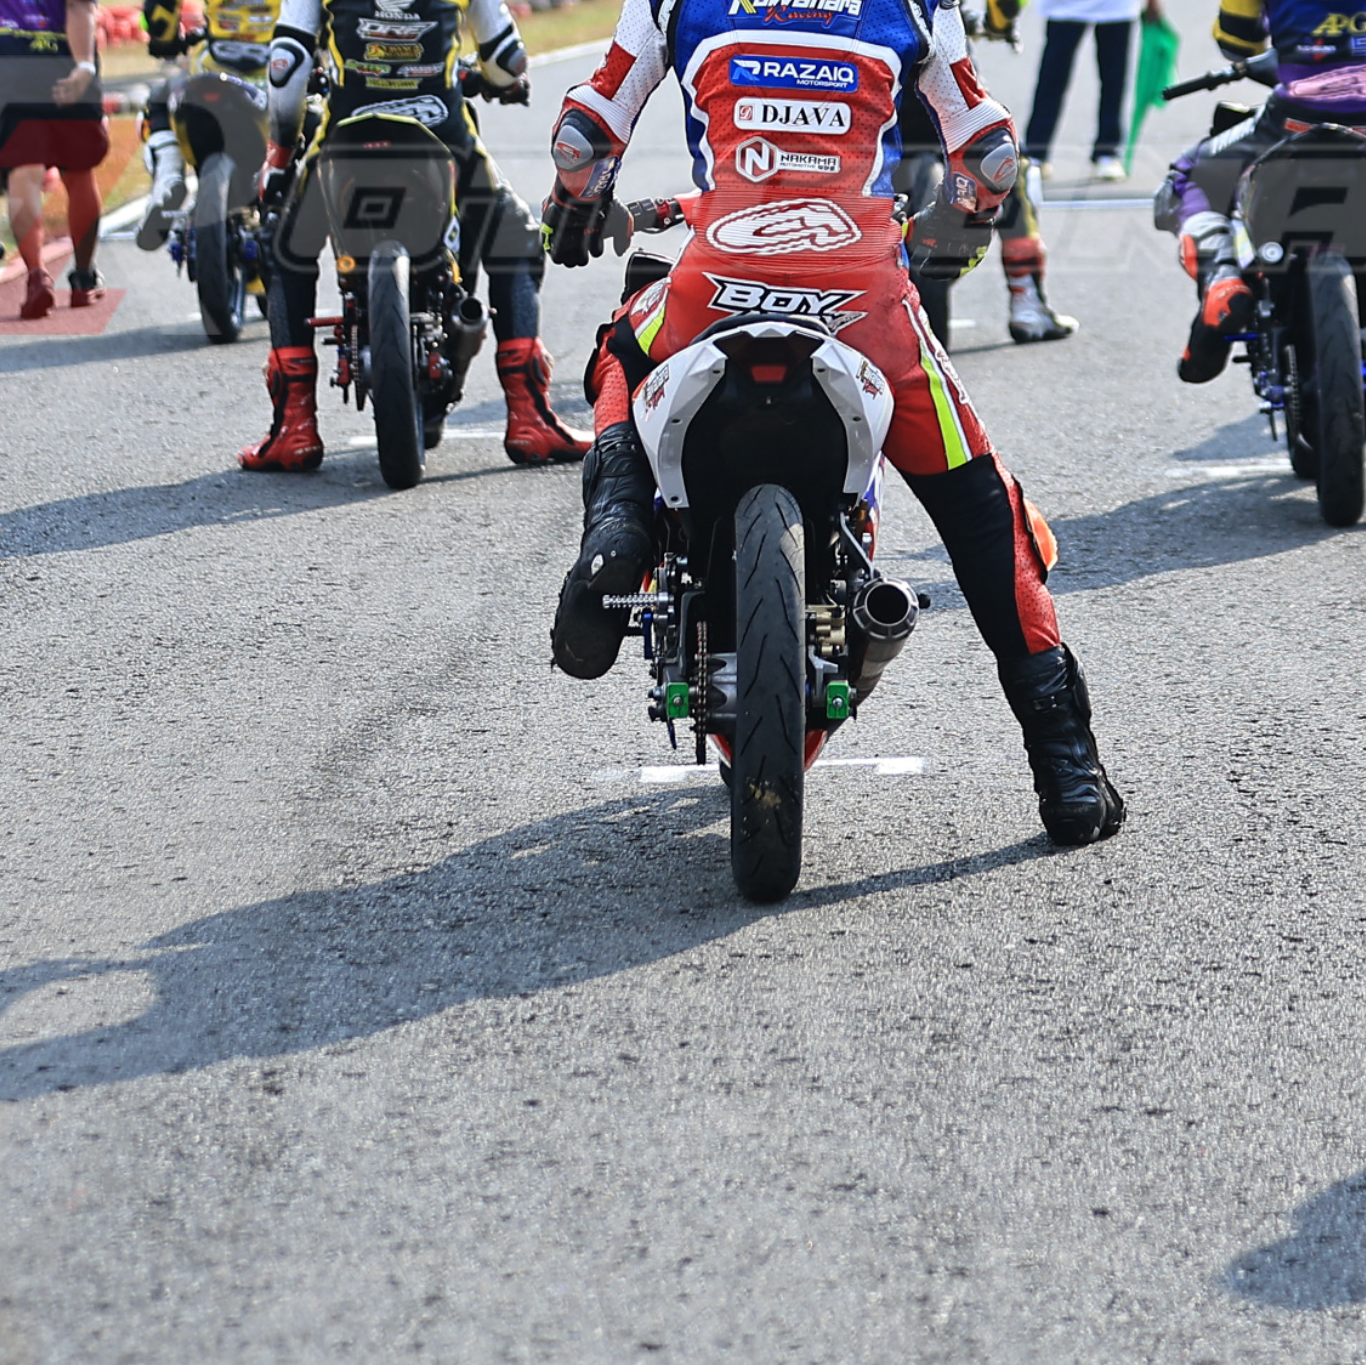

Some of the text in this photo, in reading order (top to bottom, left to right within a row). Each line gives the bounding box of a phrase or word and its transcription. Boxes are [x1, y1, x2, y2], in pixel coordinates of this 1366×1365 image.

[374, 10, 421, 20] HONDA
[764, 6, 835, 25] Racing
[762, 61, 855, 84] RAZAIQ
[796, 78, 848, 89] MOTORSPORT
[761, 104, 846, 127] DJAVA
[780, 153, 837, 166] NAKAMA
[718, 284, 841, 315] BOY
